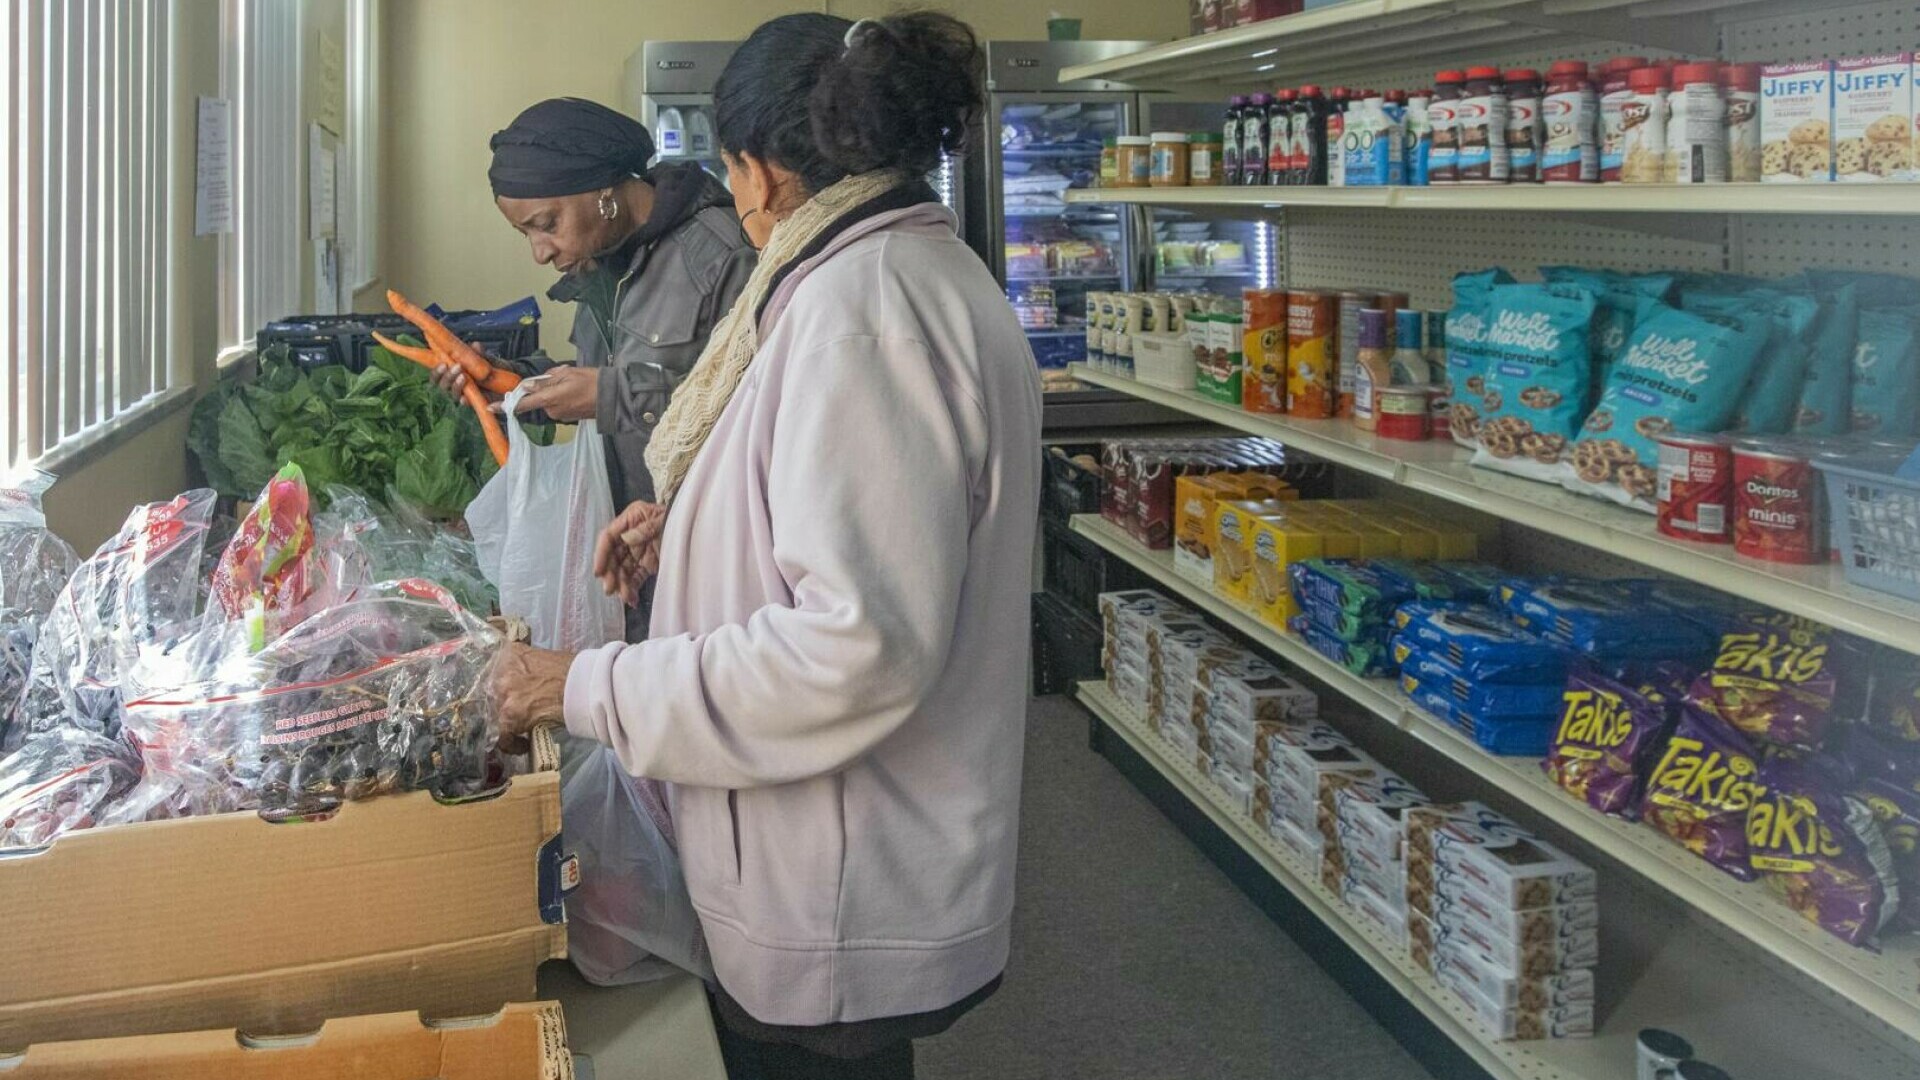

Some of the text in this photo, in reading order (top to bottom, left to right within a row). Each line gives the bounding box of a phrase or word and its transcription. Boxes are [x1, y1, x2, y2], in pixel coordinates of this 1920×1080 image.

[1764, 79, 1825, 97] JIFFY
[1837, 72, 1906, 92] JIFFY
[1498, 309, 1550, 333] Well
[1487, 322, 1560, 350] Market
[1641, 333, 1697, 361] Well
[1622, 345, 1710, 384] Market
[1746, 481, 1799, 498] Doritos
[1748, 507, 1797, 525] minis
[1713, 631, 1828, 682] Takis
[275, 717, 296, 731] RED
[1555, 691, 1633, 747] Takis
[1647, 737, 1755, 811] Takis
